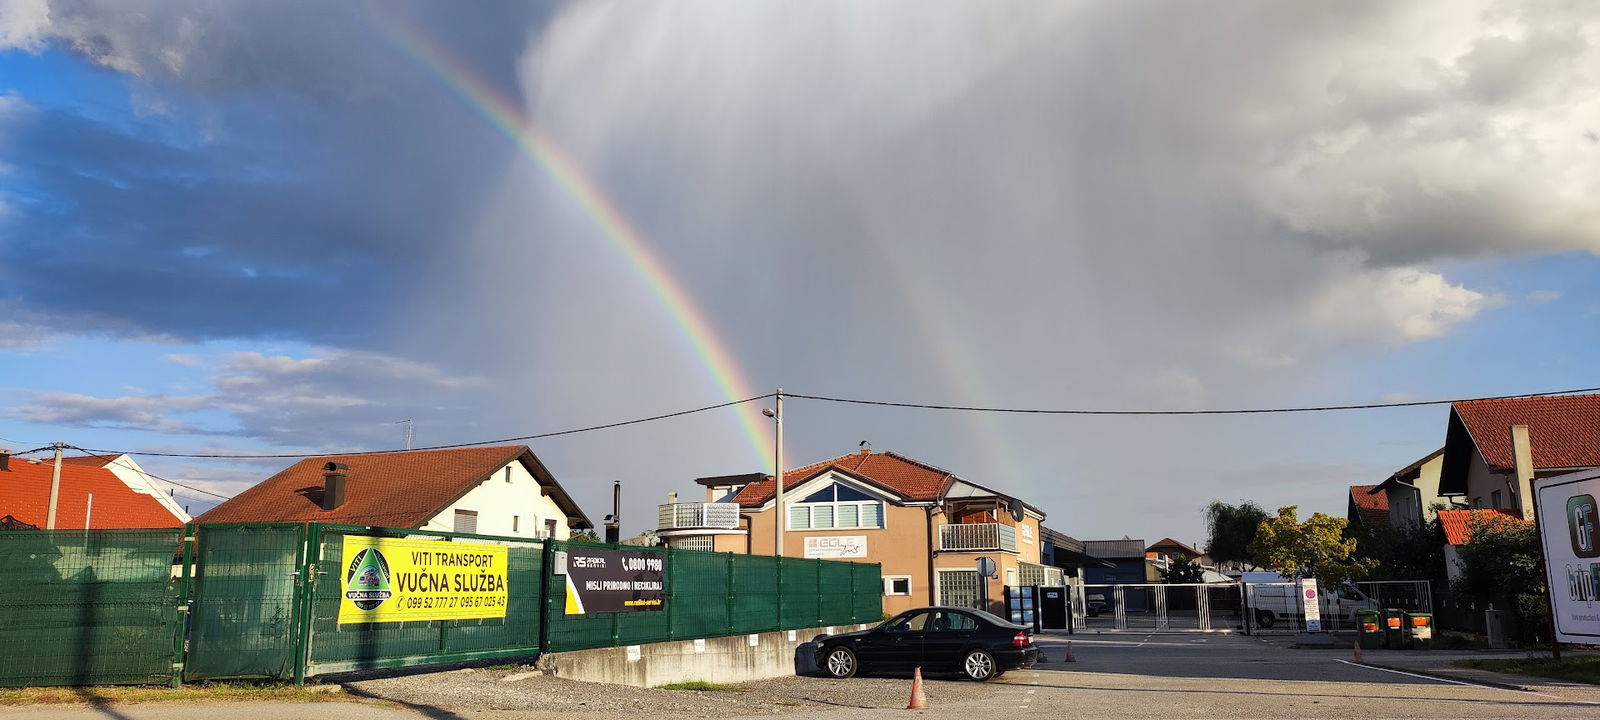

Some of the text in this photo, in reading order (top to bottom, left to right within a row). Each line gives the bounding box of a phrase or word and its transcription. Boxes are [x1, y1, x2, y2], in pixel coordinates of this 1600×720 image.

[350, 556, 362, 572] VITI
[411, 551, 494, 567] VITI TRANSPORT
[628, 557, 662, 571] 0800 9980
[396, 567, 505, 592] VUČNA SLUŽBA
[586, 580, 602, 590] MISLI
[603, 581, 630, 590] PRIRODNO
[634, 581, 662, 590] RECIKLIRAJ
[347, 591, 390, 599] VUČNA SLUŽBA
[407, 596, 505, 608] 099 52 777 27 095 67 025 43
